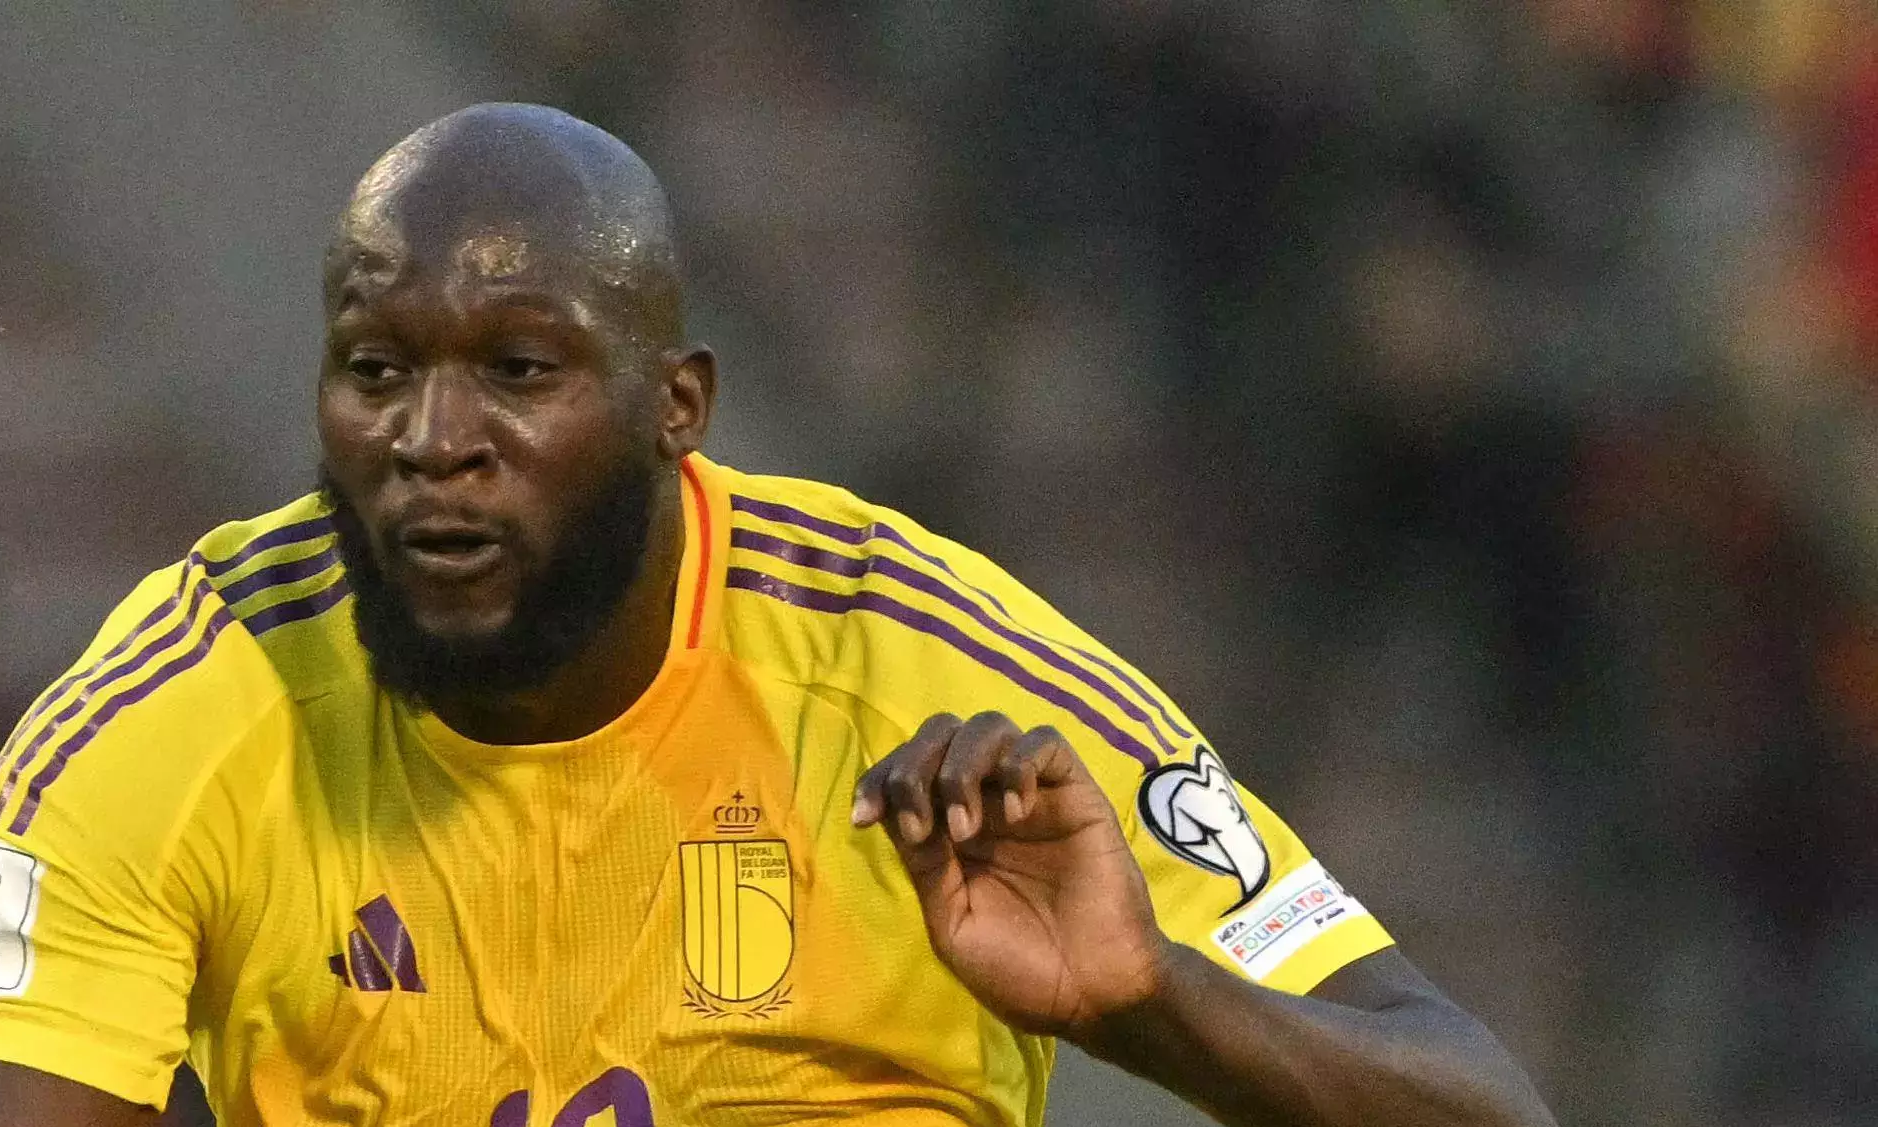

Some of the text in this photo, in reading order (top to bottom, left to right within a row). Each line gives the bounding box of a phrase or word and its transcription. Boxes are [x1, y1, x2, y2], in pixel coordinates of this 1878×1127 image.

[739, 847, 774, 857] ROYAL
[740, 858, 786, 868] BELGIAN
[741, 869, 754, 880] FA
[1232, 884, 1335, 960] FOUNDATION
[1218, 921, 1246, 943] UEFA
